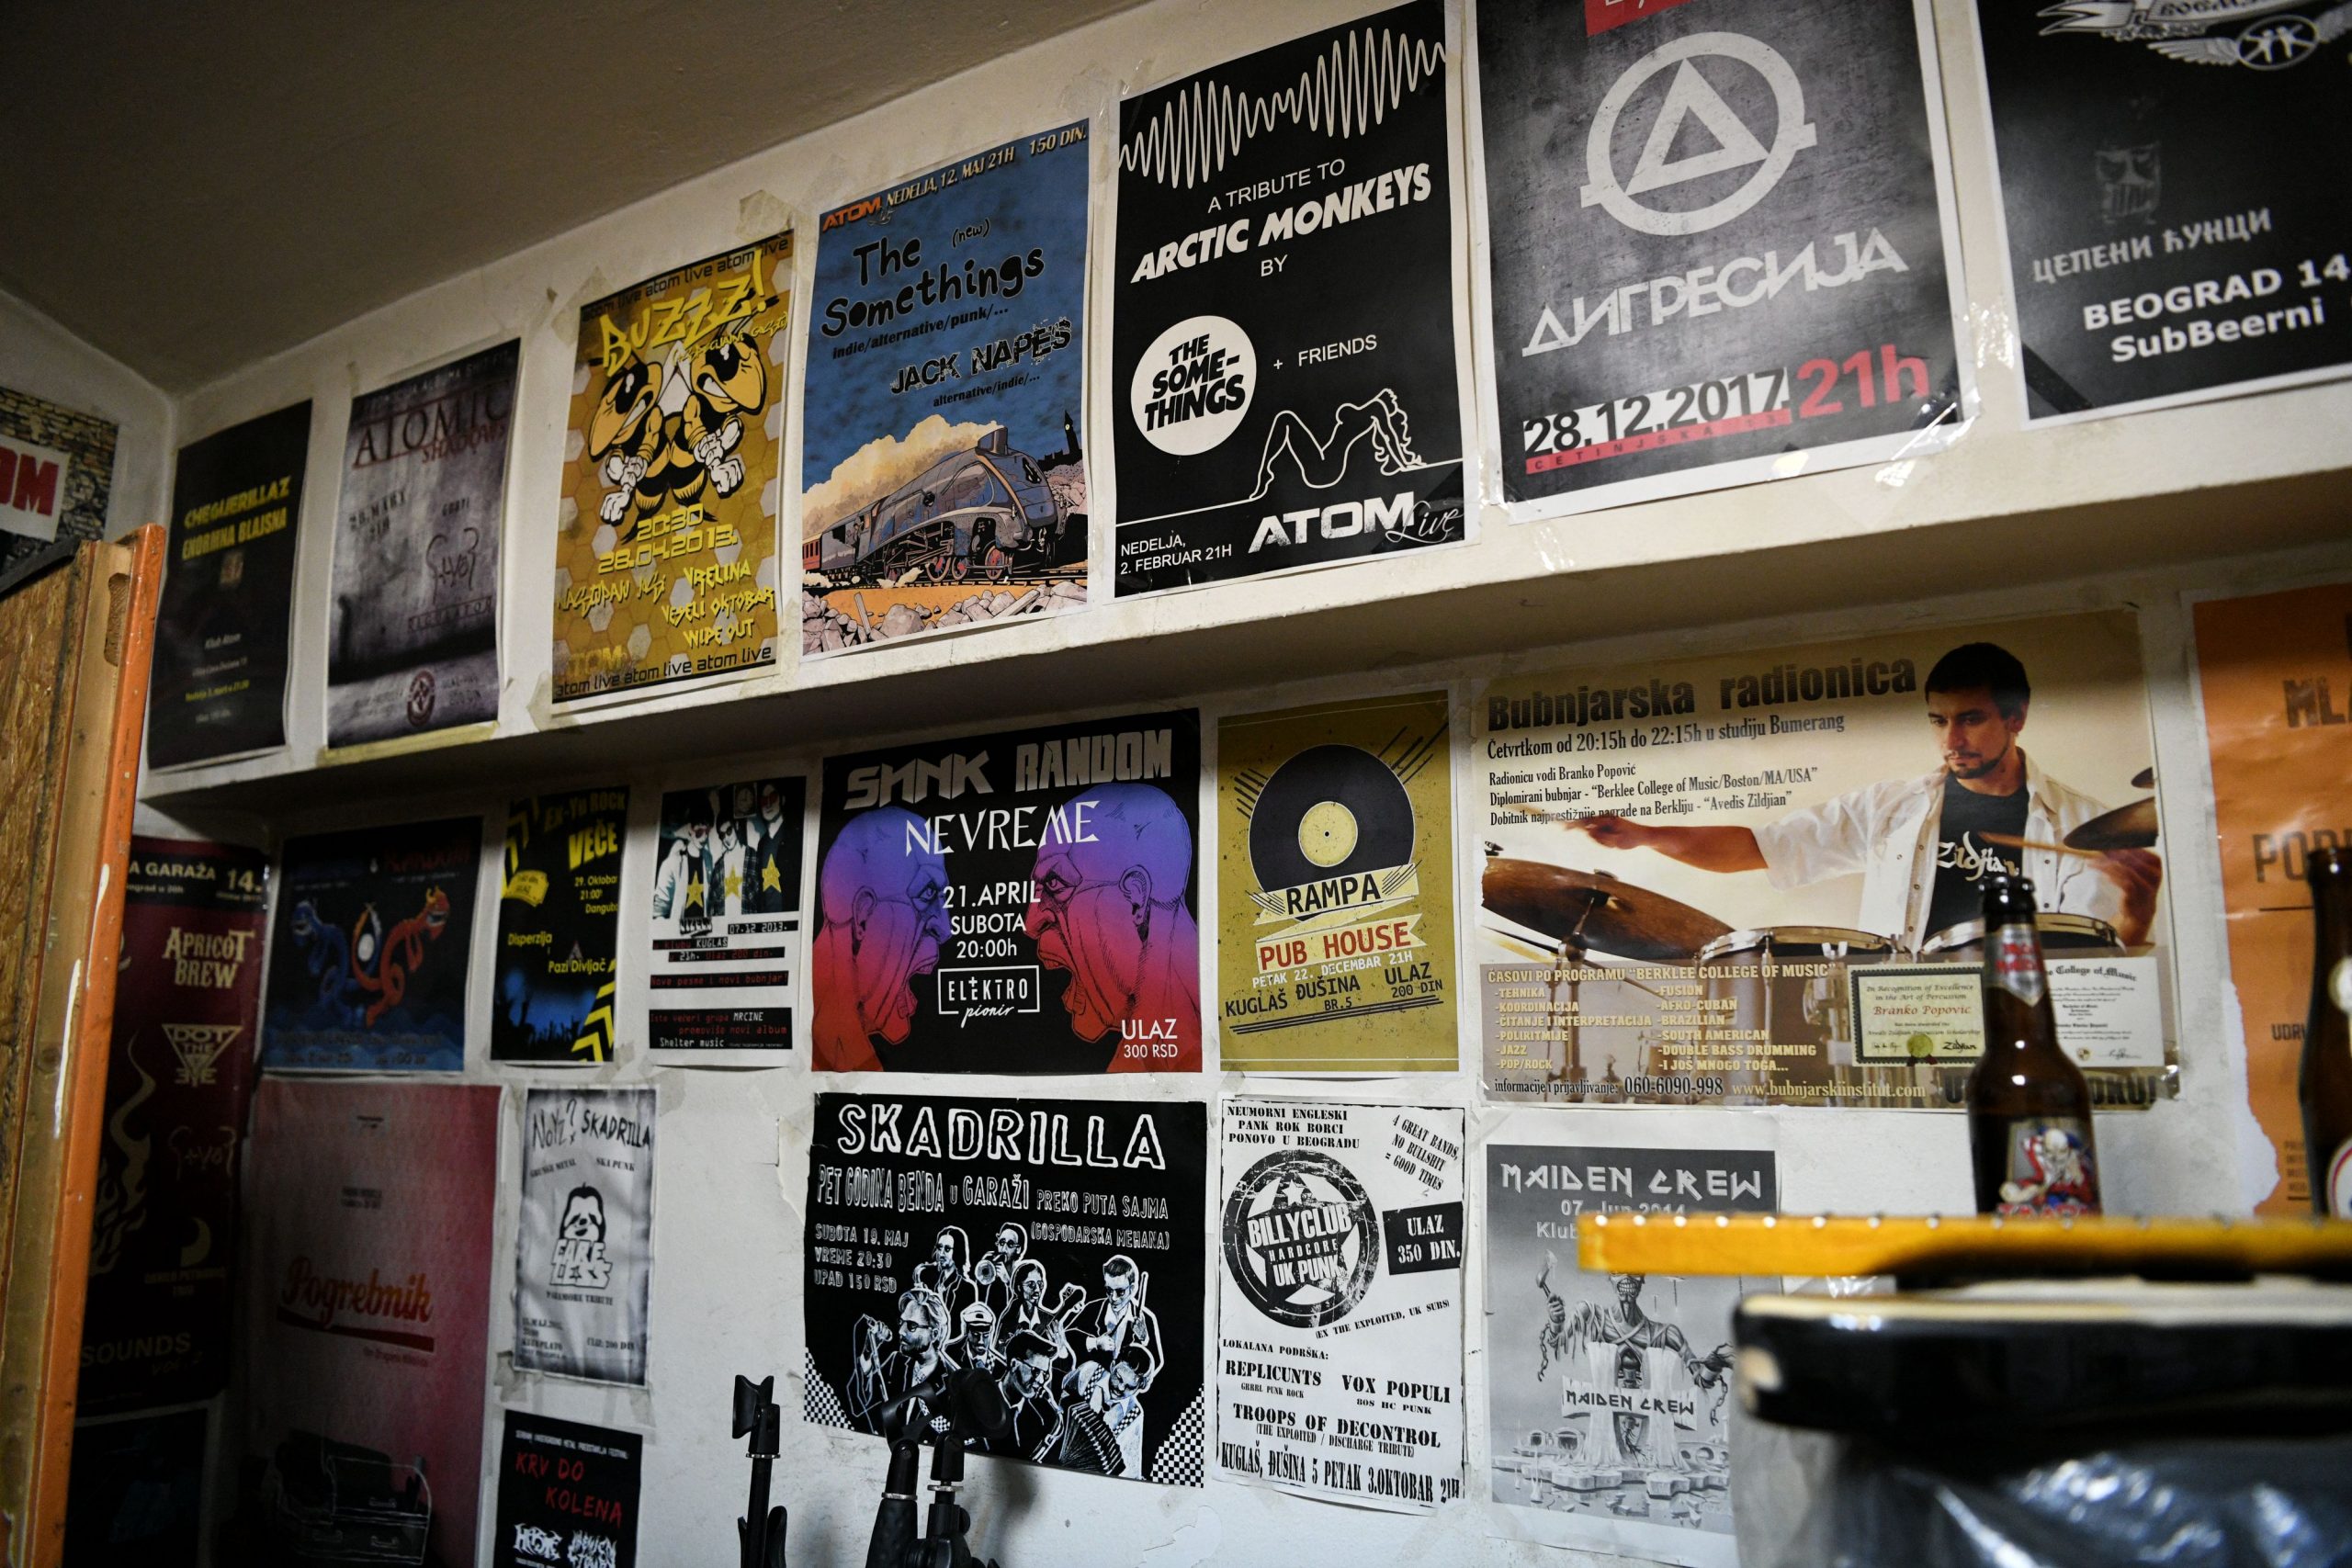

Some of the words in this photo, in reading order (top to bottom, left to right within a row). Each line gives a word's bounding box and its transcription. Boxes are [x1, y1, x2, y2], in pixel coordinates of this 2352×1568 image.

[822, 197, 881, 232] ATOM
[887, 177, 937, 206] NEDELJA,
[941, 170, 957, 188] 12.
[987, 147, 1015, 169] 21H
[1030, 135, 1057, 155] 150
[1059, 126, 1087, 147] DIN.
[1208, 197, 1221, 213] A
[1226, 168, 1311, 209] TRIBUTE
[1317, 159, 1345, 181] TO
[1130, 218, 1250, 284] ARCTIC
[1258, 163, 1431, 247] MONKEYS
[853, 237, 920, 287] The
[952, 218, 990, 248] (new)
[1261, 254, 1288, 277] BY
[821, 247, 1045, 336] Somethings
[2084, 267, 2282, 330] BEOGRAD
[600, 249, 766, 376] BUZZZ!
[2110, 297, 2325, 362] SubBeerni
[1169, 333, 1210, 367] THE
[1298, 334, 1377, 367] FRIENDS
[890, 352, 962, 394] JACK
[1152, 348, 1240, 399] SOME-
[1795, 344, 1930, 420] 21h
[1144, 374, 1245, 432] THINGS
[636, 502, 704, 542] 20:30
[1248, 491, 1415, 553] ATOM
[1120, 535, 1186, 557] NEDELJA,
[1136, 549, 1202, 572] FEBRUAR
[1205, 544, 1232, 560] 21H
[684, 559, 751, 596] VRELINA
[727, 618, 754, 638] OUT
[1487, 677, 1695, 732] Bubnjarska
[1719, 657, 1917, 711] radionica
[1487, 737, 1553, 760] Četvrtkom
[1556, 739, 1572, 753] od
[1577, 731, 1626, 751] 20:15h
[1631, 728, 1646, 748] do
[1651, 724, 1702, 746] 22:15h
[1770, 714, 1844, 735] Bumerang
[1015, 728, 1172, 793] RANDOM
[1489, 771, 1533, 786] Radionicu
[1536, 767, 1556, 782] vodi
[1558, 765, 1594, 780] Branko
[1597, 762, 1636, 779] Popović
[1545, 786, 1581, 804] bubnjar
[1637, 779, 1673, 797] College
[1676, 777, 1687, 792] of
[905, 800, 1100, 858] NEVREME
[145, 863, 216, 880] GARAŽA
[1285, 874, 1381, 915] RAMPA
[950, 912, 1026, 935] SUBOTA
[163, 927, 255, 963] APRICOT
[956, 939, 1017, 959] 20:00h
[1260, 940, 1307, 971] PUB
[1323, 921, 1411, 959] HOUSE
[175, 960, 236, 989] BREW
[1252, 972, 1287, 989] PETAK
[1321, 956, 1381, 976] DECEMBAR
[1389, 951, 1413, 965] 21H
[1535, 970, 1552, 982] PO
[1554, 968, 1625, 982] PROGRAMU
[1699, 965, 1758, 979] COLLEGE
[1761, 964, 1779, 977] OF
[1225, 988, 1288, 1018] KUGLAŠ
[1295, 974, 1361, 1000] ĐUŠINA
[1384, 962, 1432, 986] ULAZ
[961, 1005, 1014, 1029] pionir
[1121, 1018, 1178, 1040] ULAZ
[1554, 1016, 1652, 1027] INTERPRETACIJA
[660, 1037, 695, 1049] Shelter
[699, 1038, 725, 1049] music
[1124, 1044, 1148, 1059] 300
[1153, 1043, 1178, 1058] RSD
[1705, 1030, 1770, 1041] AMERICAN
[1712, 1045, 1744, 1055] BASS
[1624, 1077, 1724, 1095] 060-6090-998
[1227, 1106, 1286, 1118] NEUMORNI
[1293, 1108, 1348, 1121] ENGLESKI
[1238, 1120, 1269, 1132] PANK
[1275, 1122, 1300, 1134] ROK
[1307, 1122, 1343, 1134] BORCI
[837, 1103, 1166, 1169] SKADRILLA
[1228, 1133, 1275, 1145] PONOVO
[1283, 1135, 1290, 1145] U
[1296, 1136, 1360, 1149] BEOGRADU
[818, 1164, 842, 1204] PET
[845, 1167, 893, 1210] GODINA
[898, 1170, 944, 1213] BENDA
[963, 1173, 1030, 1211] GARAŽI
[1036, 1190, 1079, 1213] PREKO
[1082, 1191, 1118, 1216] PUTA
[1122, 1196, 1169, 1220] SAJMA
[1499, 1163, 1634, 1198] MAIDEN
[1647, 1168, 1761, 1201] CREW
[815, 1223, 857, 1244] SUBOTA
[884, 1229, 910, 1248] MAJ
[1247, 1203, 1352, 1248] BILLYCLUB
[1407, 1215, 1444, 1237] ULAZ
[856, 1249, 892, 1269] 20:30
[1269, 1238, 1339, 1262] HARDCORE
[1397, 1243, 1422, 1264] 350
[1430, 1240, 1461, 1261] DIN.
[1272, 1264, 1295, 1287] UK
[1299, 1254, 1341, 1284] PUNK
[1332, 1324, 1351, 1336] THE
[1226, 1359, 1322, 1386] REPLICUNTS
[1341, 1374, 1376, 1394] VOX
[1386, 1380, 1451, 1404] POPULI
[1286, 1389, 1305, 1399] ROCK
[1566, 1390, 1633, 1412] MAIDEN
[1640, 1397, 1694, 1416] CREW
[1233, 1403, 1296, 1427] TROOPS
[1306, 1414, 1328, 1432] OF
[1337, 1418, 1442, 1449] DECONTROL
[515, 1450, 549, 1479] KRV
[558, 1457, 584, 1482] DO
[1268, 1444, 1306, 1483] ĐUŠINA
[1312, 1458, 1318, 1484] 5
[1324, 1461, 1362, 1492] PETAK
[546, 1486, 623, 1529] KOLENA
